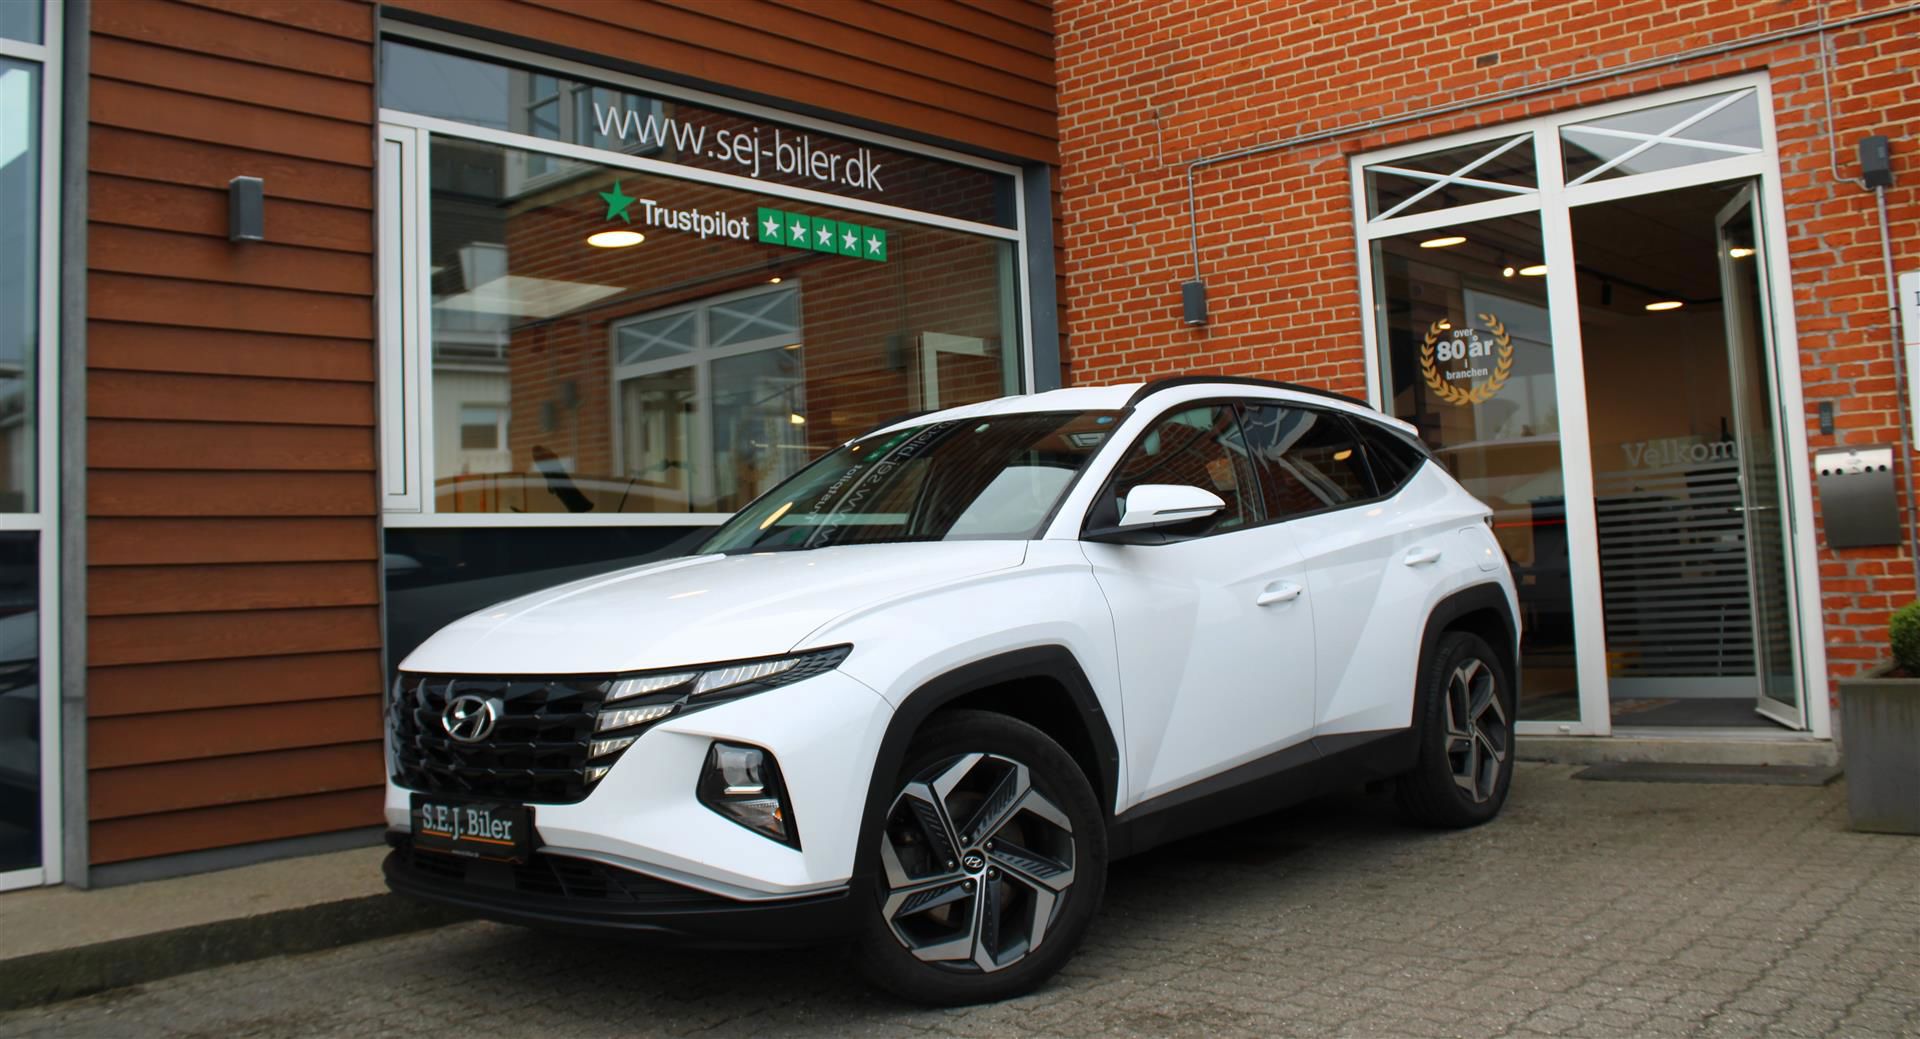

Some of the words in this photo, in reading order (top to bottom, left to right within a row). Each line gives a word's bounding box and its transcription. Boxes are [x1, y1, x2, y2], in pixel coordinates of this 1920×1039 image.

[593, 102, 883, 192] www.sej-biler.dk
[639, 198, 750, 241] Trustpilot
[1437, 339, 1466, 362] 80
[1468, 335, 1494, 357] år
[1453, 328, 1474, 338] over
[1446, 367, 1489, 381] branchen
[422, 804, 464, 840] S.E.J.
[467, 810, 512, 840] Biler
